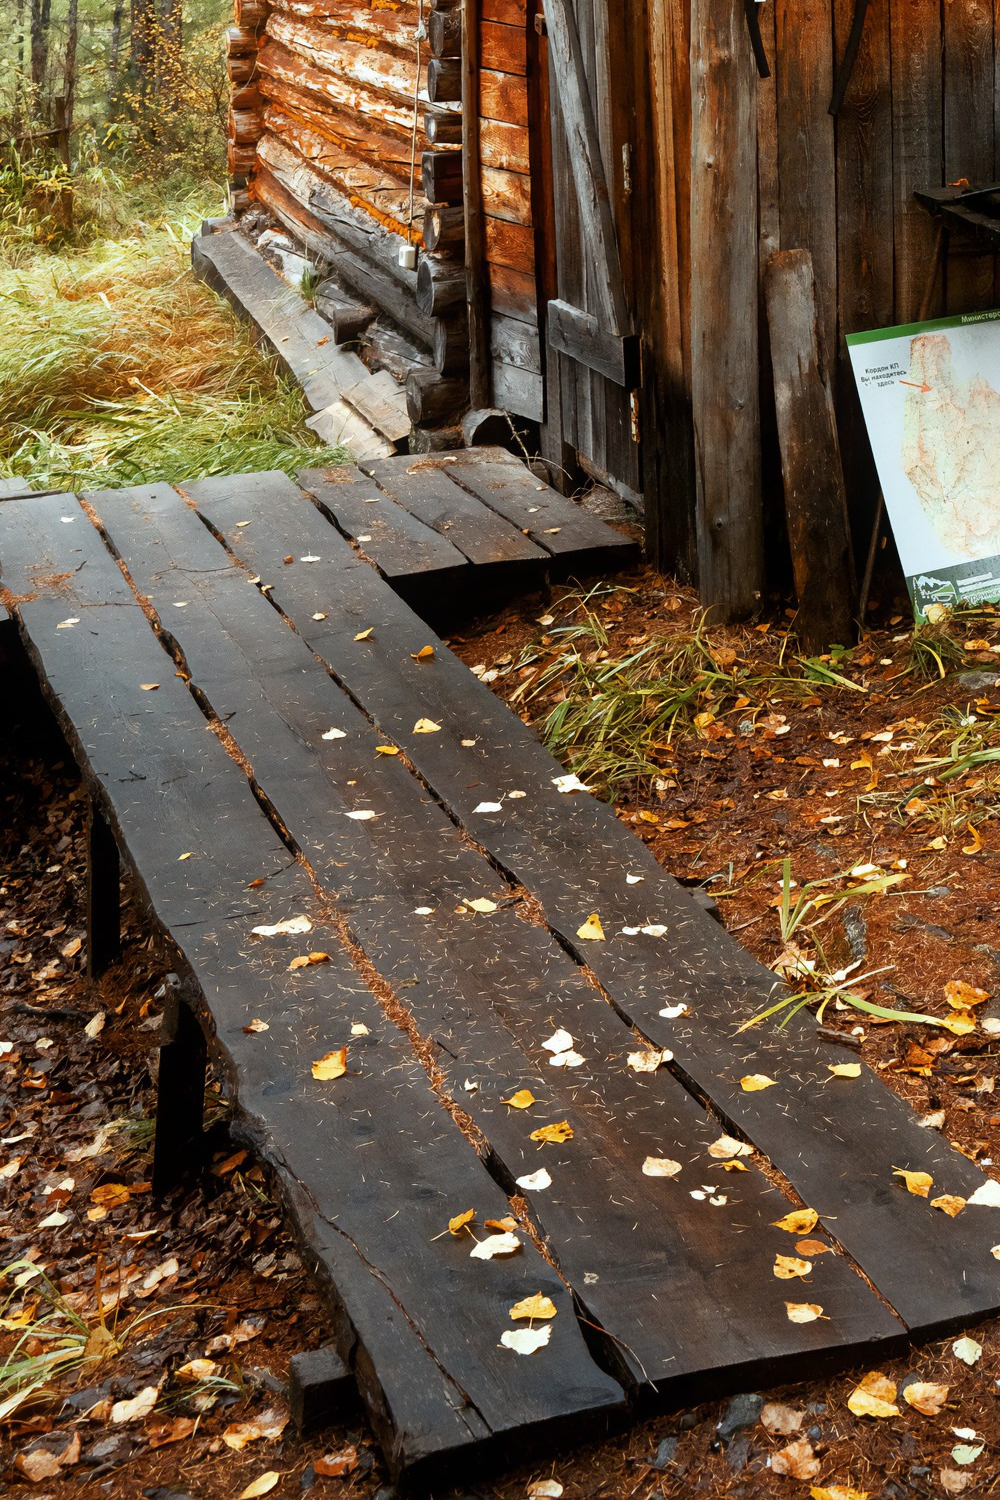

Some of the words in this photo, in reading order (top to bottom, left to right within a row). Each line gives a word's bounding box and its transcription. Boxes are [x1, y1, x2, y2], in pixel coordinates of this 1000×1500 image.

[865, 365, 889, 375] Кордон
[889, 362, 899, 370] КП
[871, 370, 907, 381] находитесь
